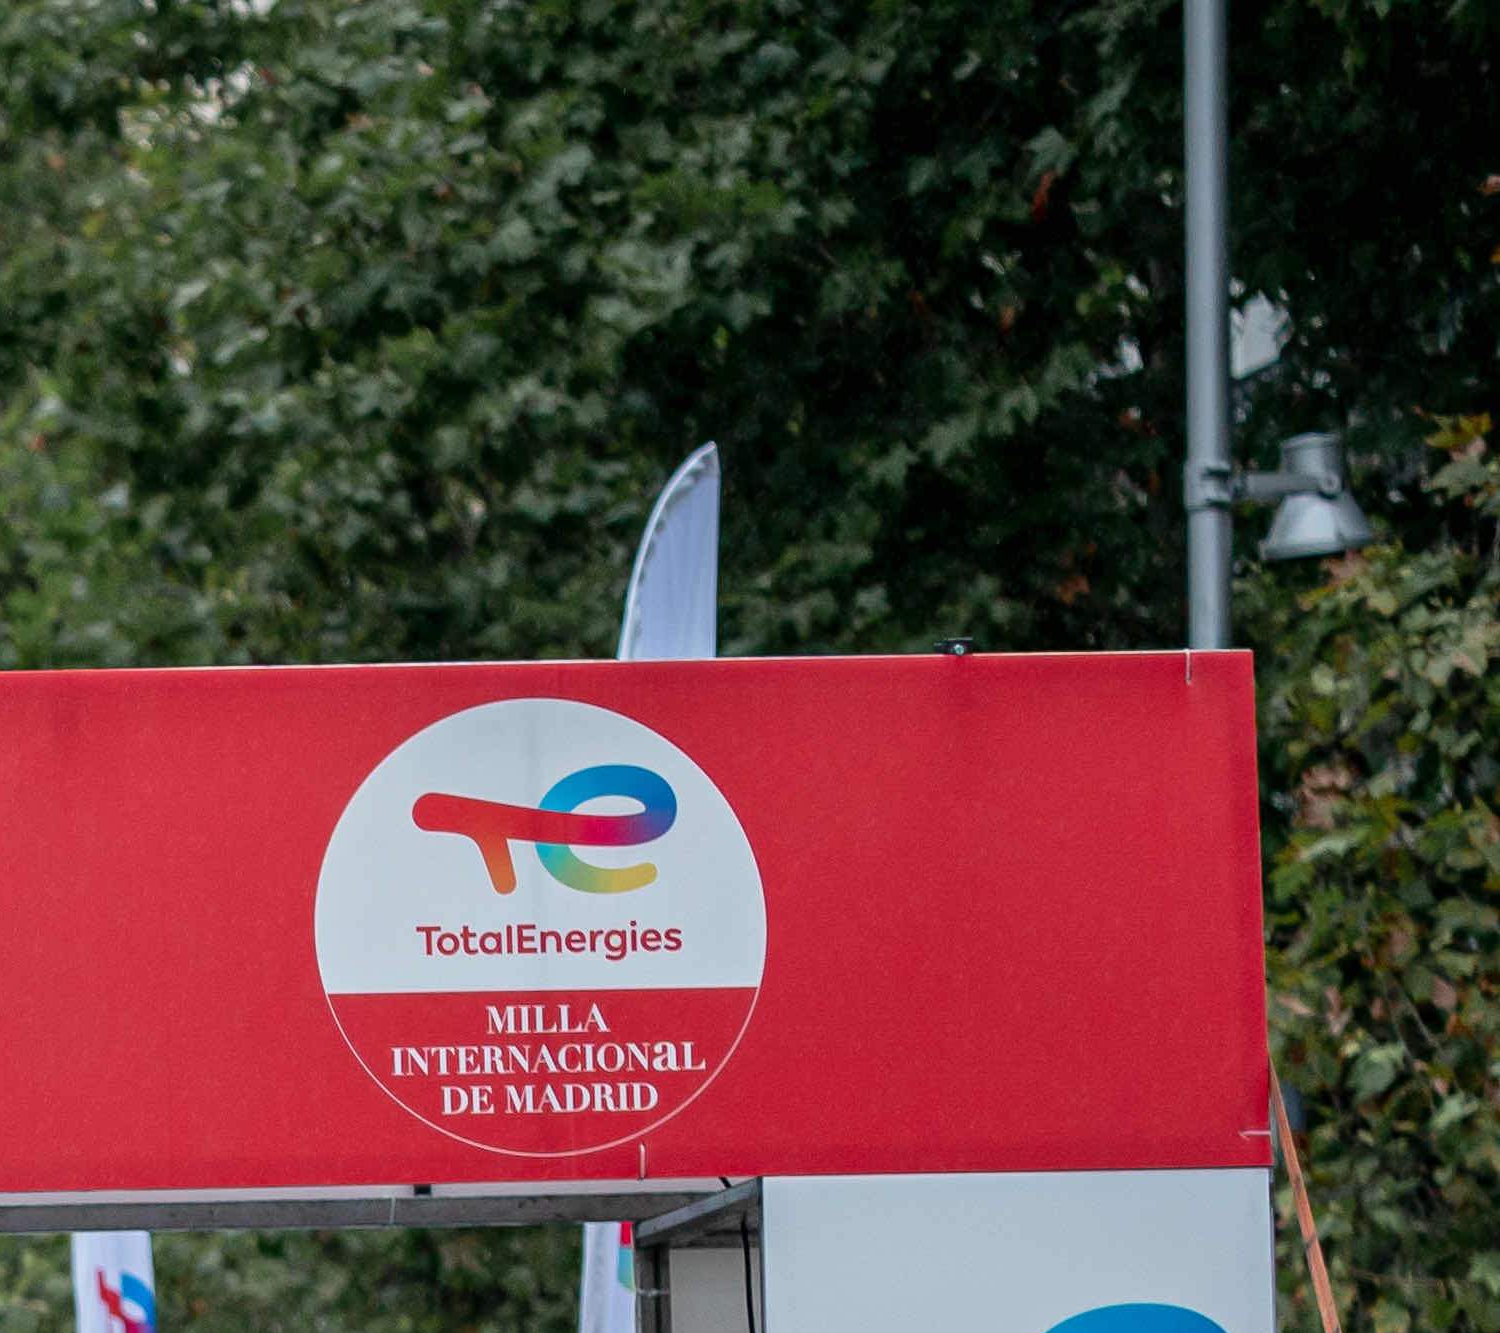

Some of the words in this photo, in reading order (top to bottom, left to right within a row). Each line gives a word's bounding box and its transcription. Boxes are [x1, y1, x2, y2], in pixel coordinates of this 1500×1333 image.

[416, 921, 682, 960] TotalEnergies
[487, 1003, 610, 1034] MILLA
[442, 1085, 495, 1115] DE
[504, 1082, 658, 1114] MADRID
